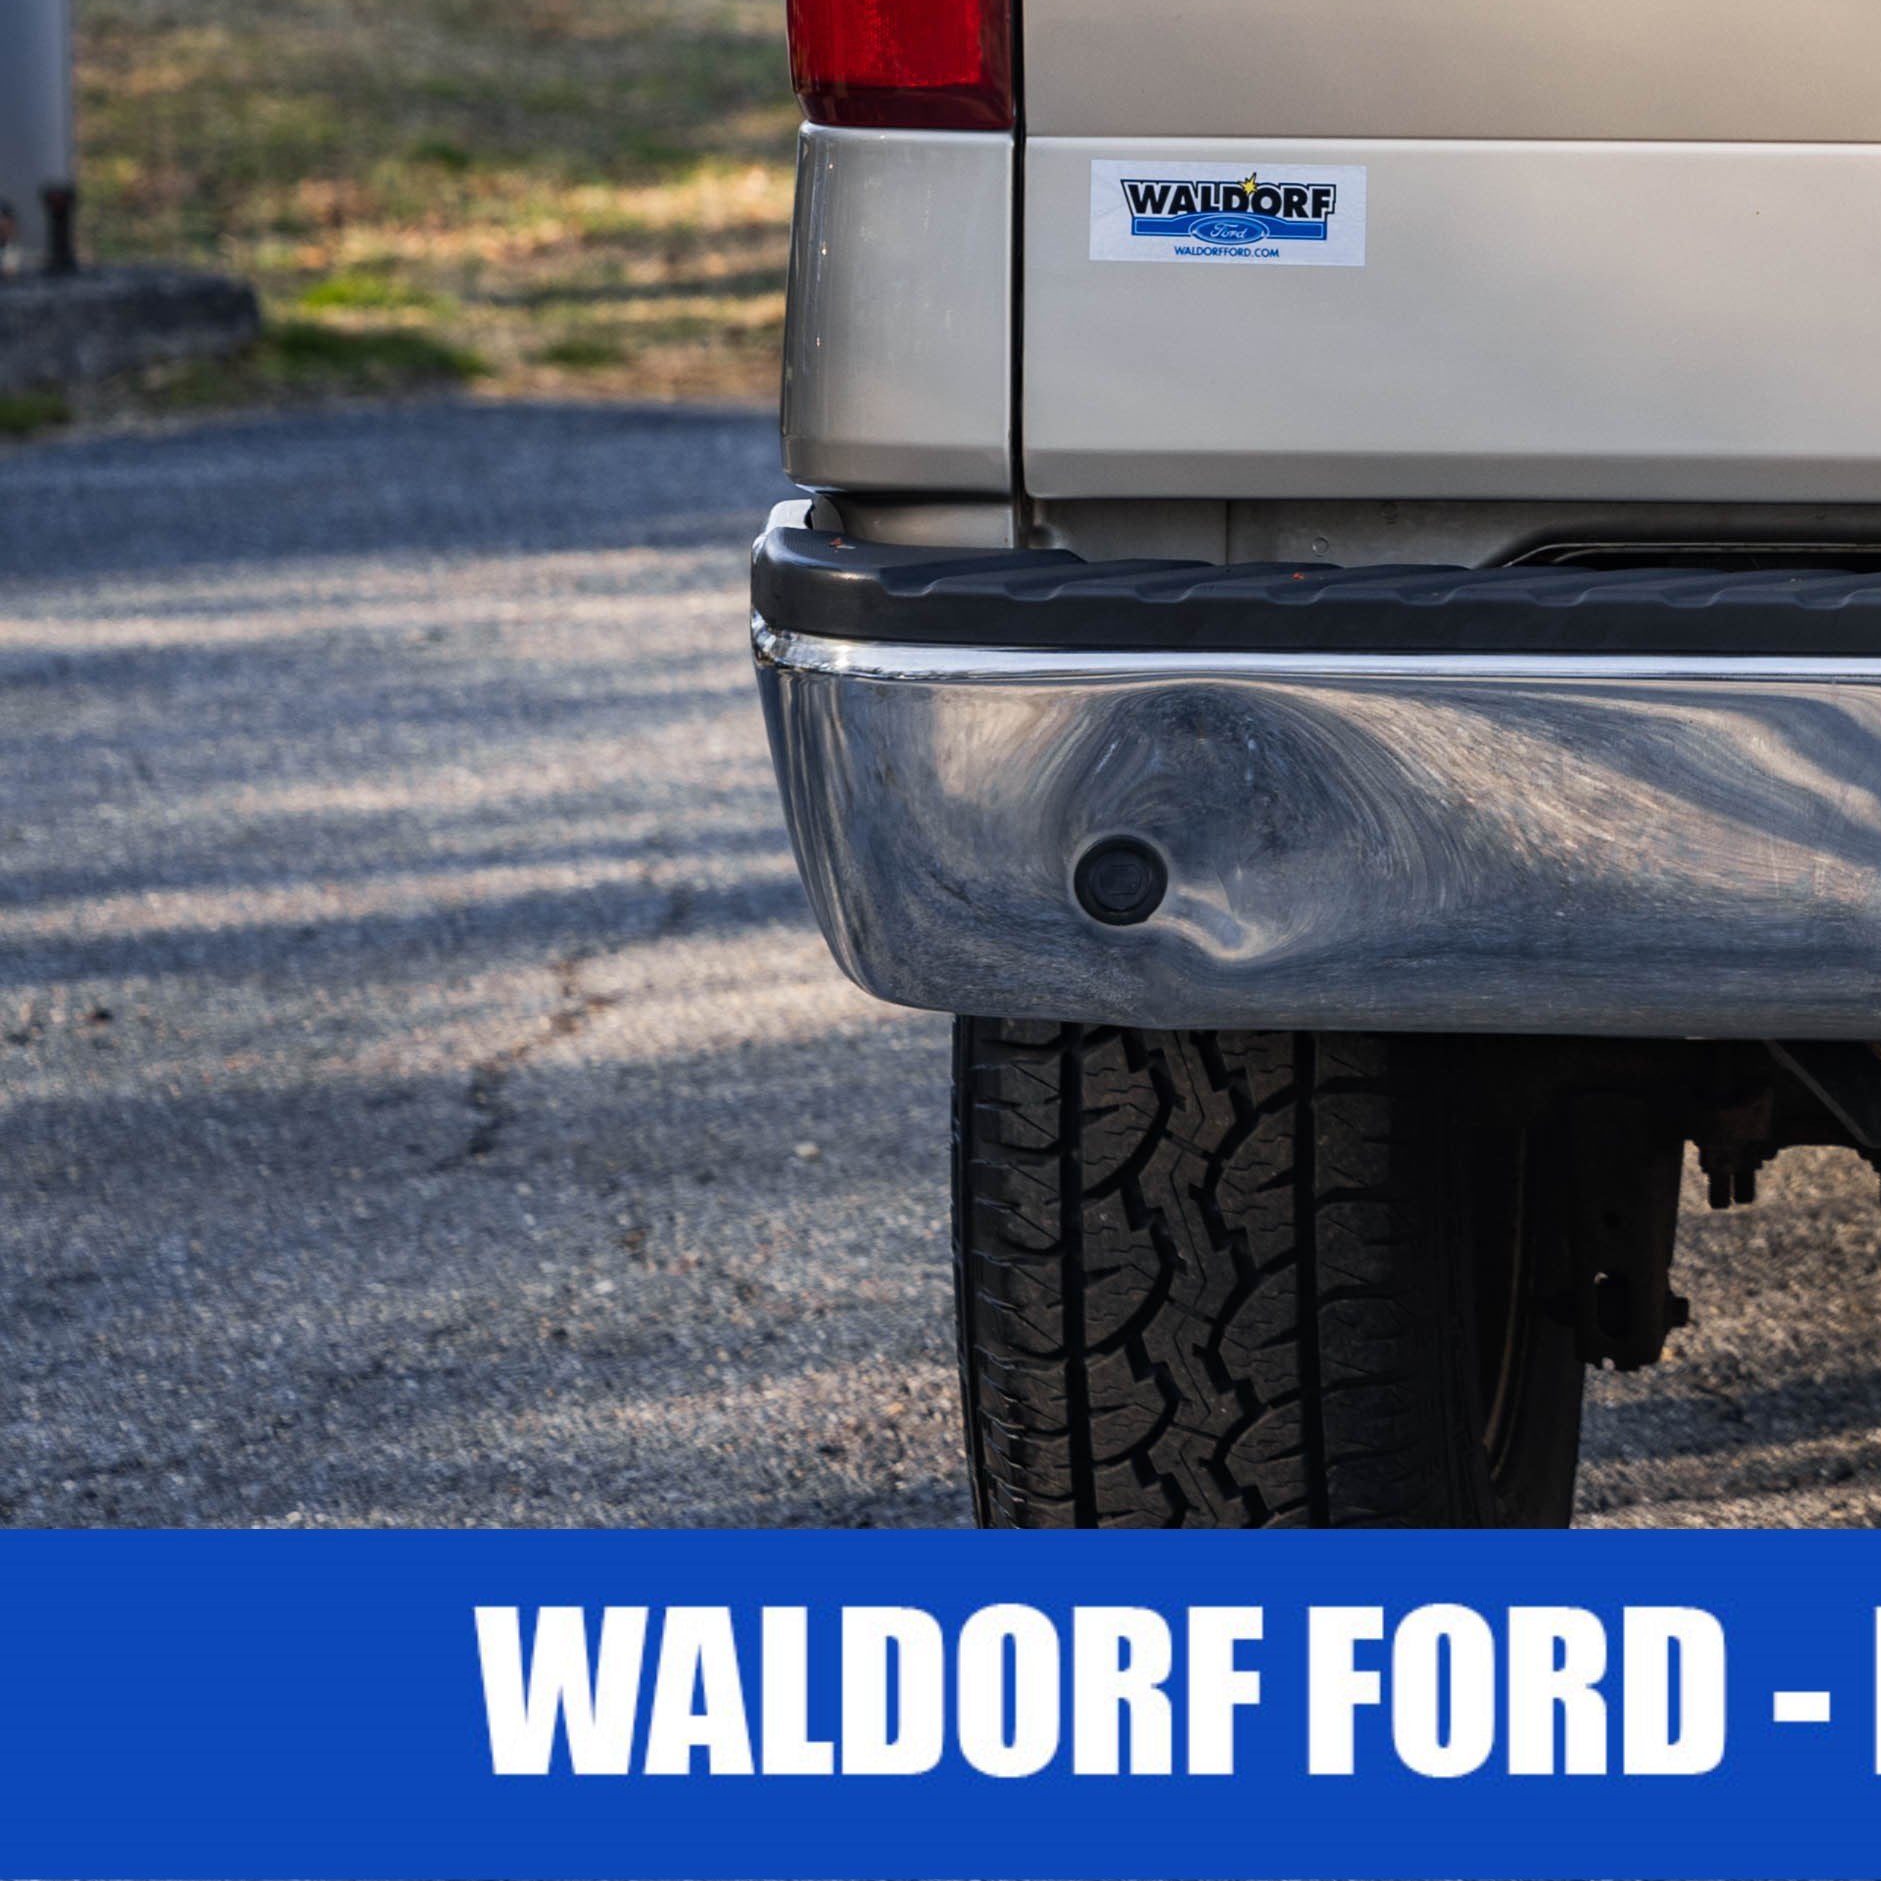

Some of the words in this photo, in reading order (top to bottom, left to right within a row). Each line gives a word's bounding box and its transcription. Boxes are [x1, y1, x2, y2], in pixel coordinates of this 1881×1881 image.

[1127, 183, 1332, 218] WALDORF
[1209, 223, 1249, 239] Ford
[1174, 245, 1280, 258] WALDORFFORD.COM
